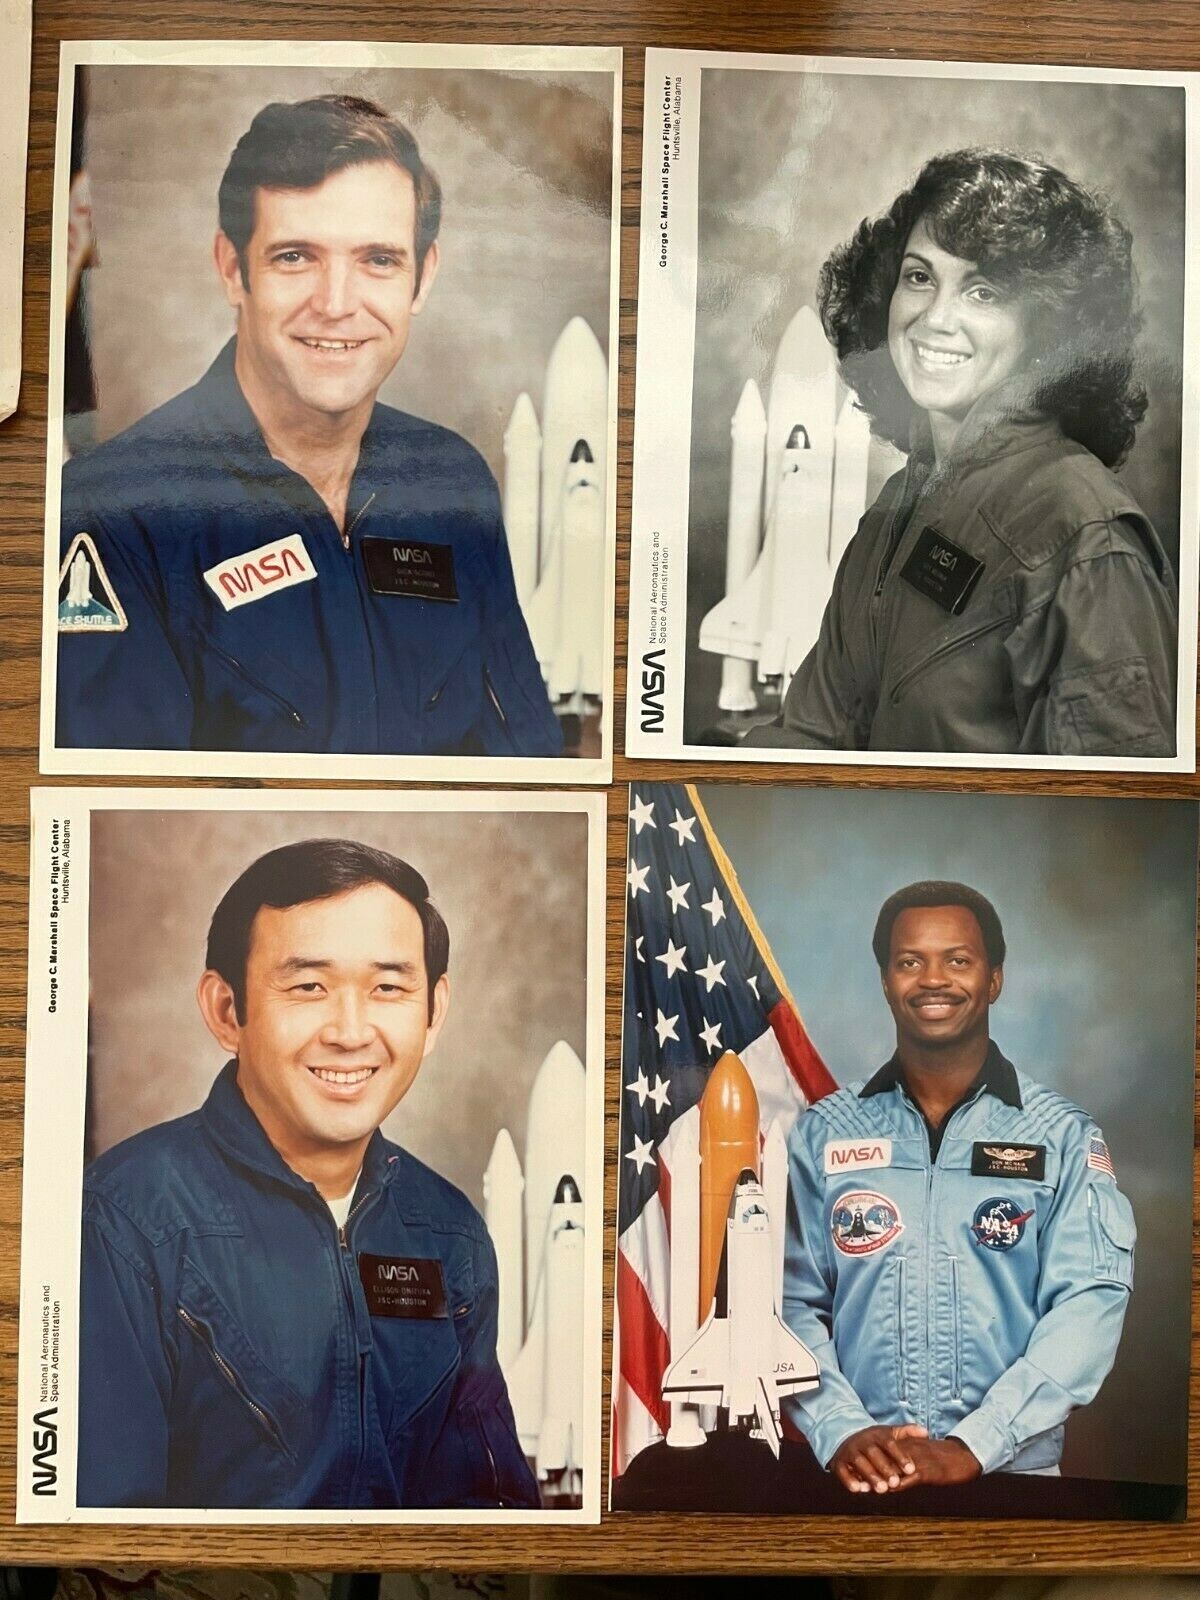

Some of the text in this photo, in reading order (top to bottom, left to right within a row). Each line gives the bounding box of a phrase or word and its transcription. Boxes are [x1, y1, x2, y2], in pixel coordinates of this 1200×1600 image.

[663, 76, 671, 110] Center
[663, 113, 671, 141] Flight
[673, 117, 681, 160] Huntsville,
[662, 144, 670, 174] Space
[660, 221, 668, 230] C.
[659, 233, 668, 267] George
[393, 547, 432, 564] NASA
[929, 545, 958, 571] NASA
[218, 549, 305, 598] NASA
[650, 551, 659, 603] Aeronautics
[659, 547, 669, 644] Space Administration
[74, 615, 112, 625] SHUTTLE
[649, 606, 657, 644] National
[640, 649, 665, 733] NASA
[51, 819, 59, 853] Center
[51, 856, 60, 884] Flight
[61, 819, 70, 903] Huntsville, Alabama
[50, 887, 59, 918] Space
[49, 921, 58, 963] Marshall
[48, 977, 58, 1013] George
[832, 1147, 883, 1165] NASA
[980, 1215, 1019, 1236] NASA
[378, 1265, 419, 1281] NASA
[41, 1305, 49, 1360] Aeronautics
[50, 1301, 60, 1402] Space Administration
[40, 1364, 48, 1402] National
[32, 1407, 58, 1495] NASA
